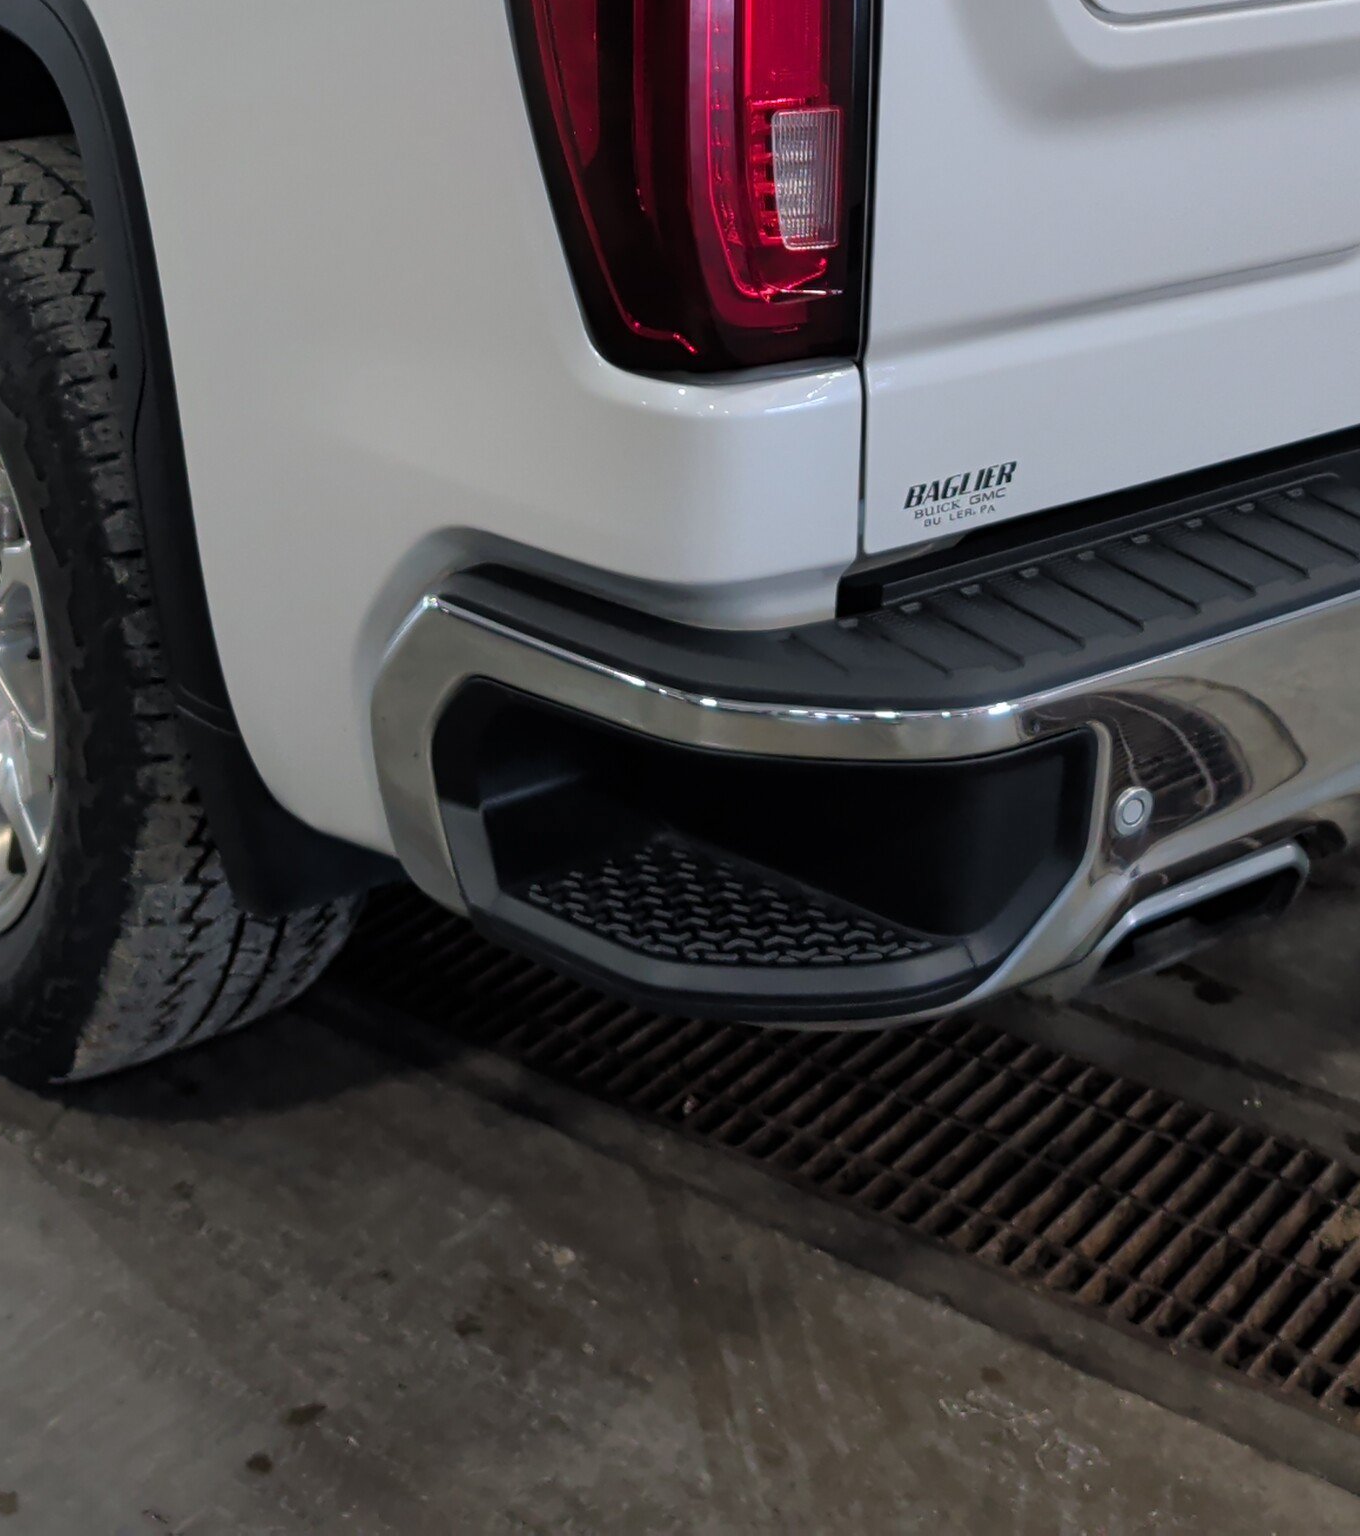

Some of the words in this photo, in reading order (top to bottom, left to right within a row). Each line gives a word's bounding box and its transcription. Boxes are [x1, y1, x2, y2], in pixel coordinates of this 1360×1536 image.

[903, 461, 1017, 509] BAGLIER
[914, 499, 960, 520] BUICK
[969, 487, 1007, 505] GMC
[980, 504, 996, 514] PA
